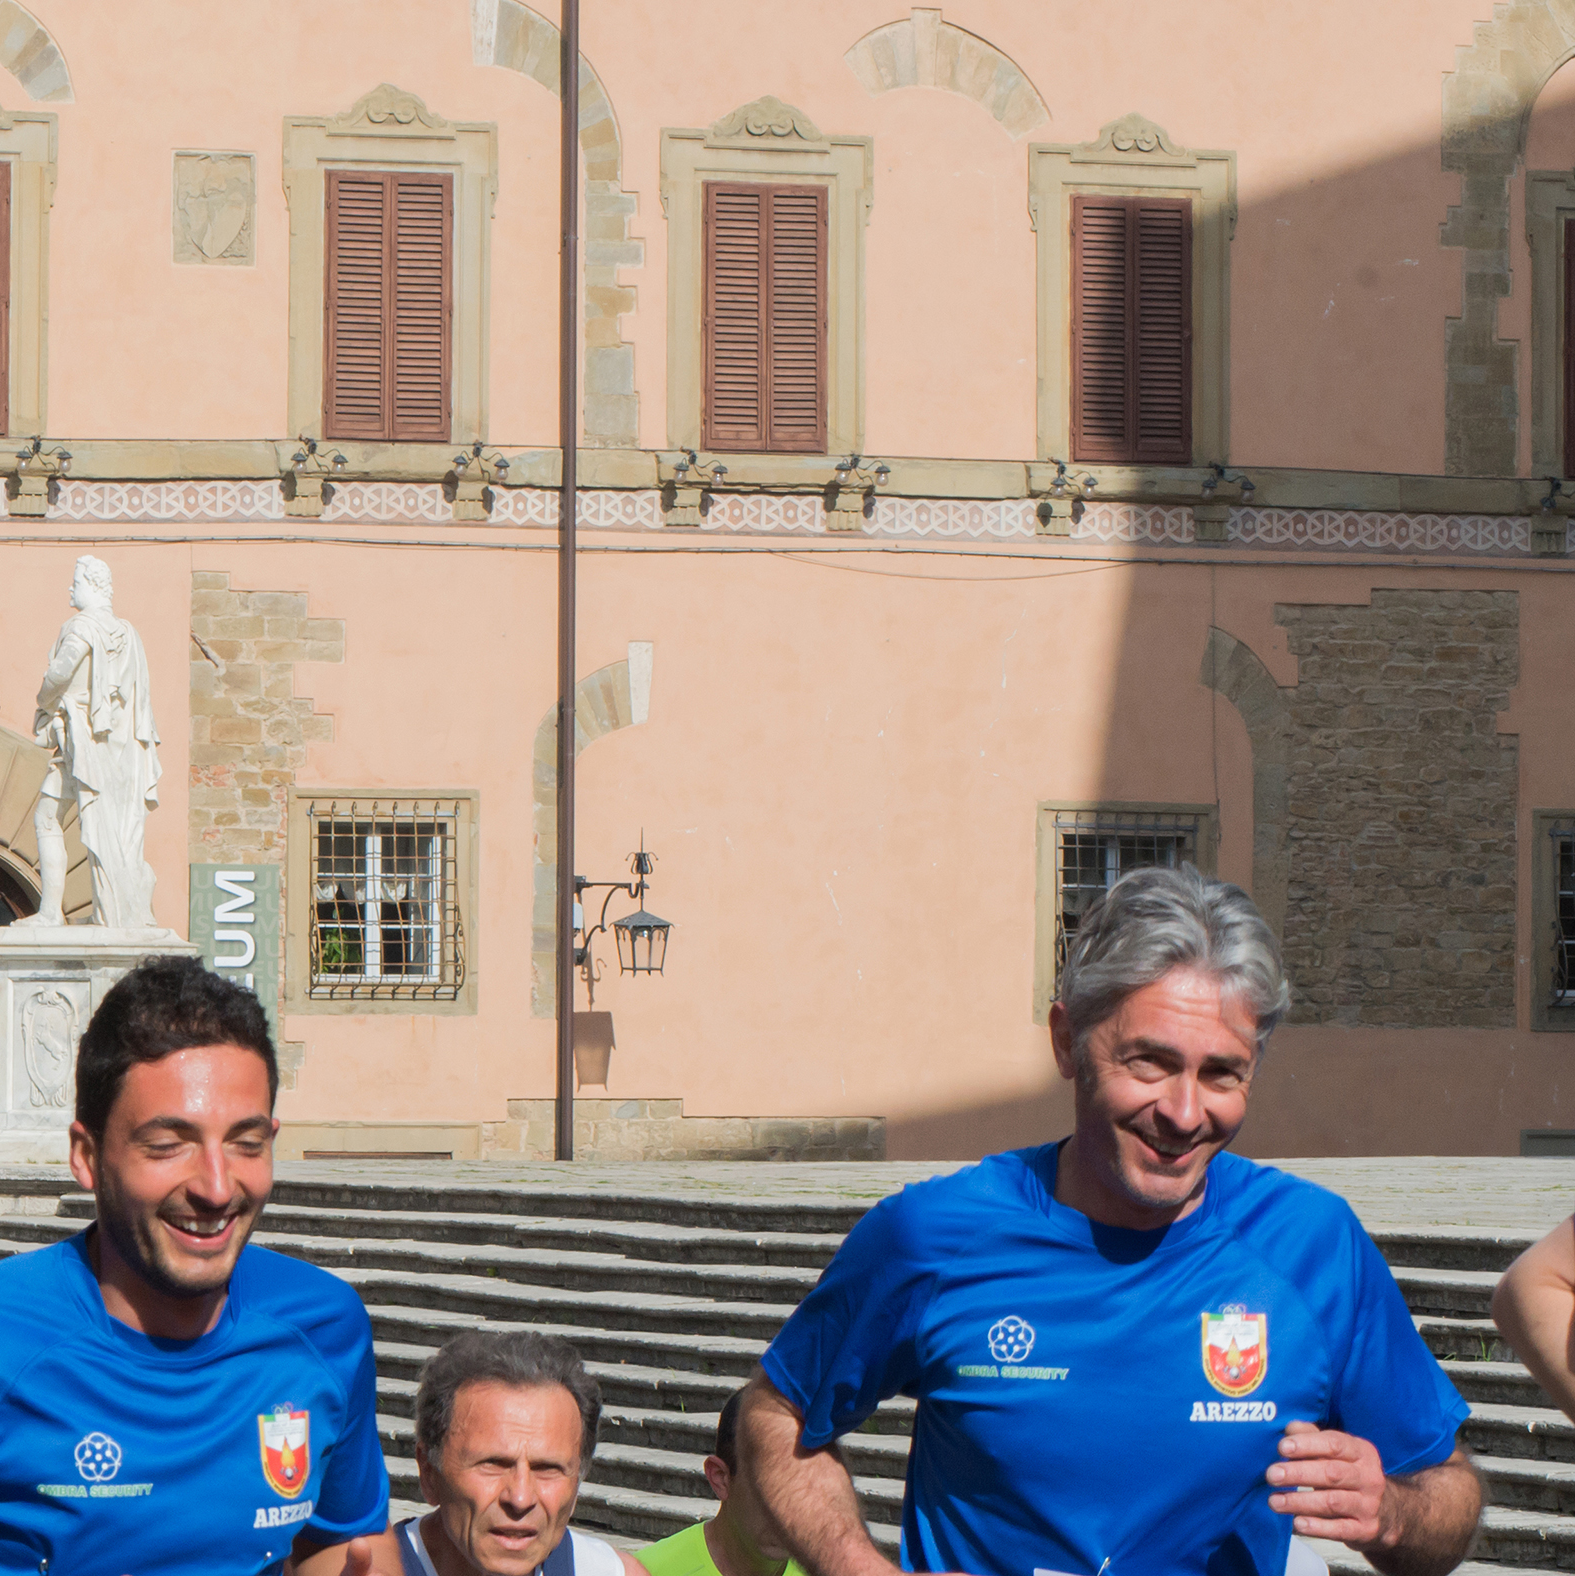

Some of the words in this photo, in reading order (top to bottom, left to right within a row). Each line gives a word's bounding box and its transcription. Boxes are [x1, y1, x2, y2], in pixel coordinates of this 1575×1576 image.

[1001, 1366, 1069, 1380] SECURITY
[1189, 1401, 1277, 1422] AREZZO
[89, 1483, 153, 1498] SECURITY
[253, 1500, 312, 1529] AREZZO
